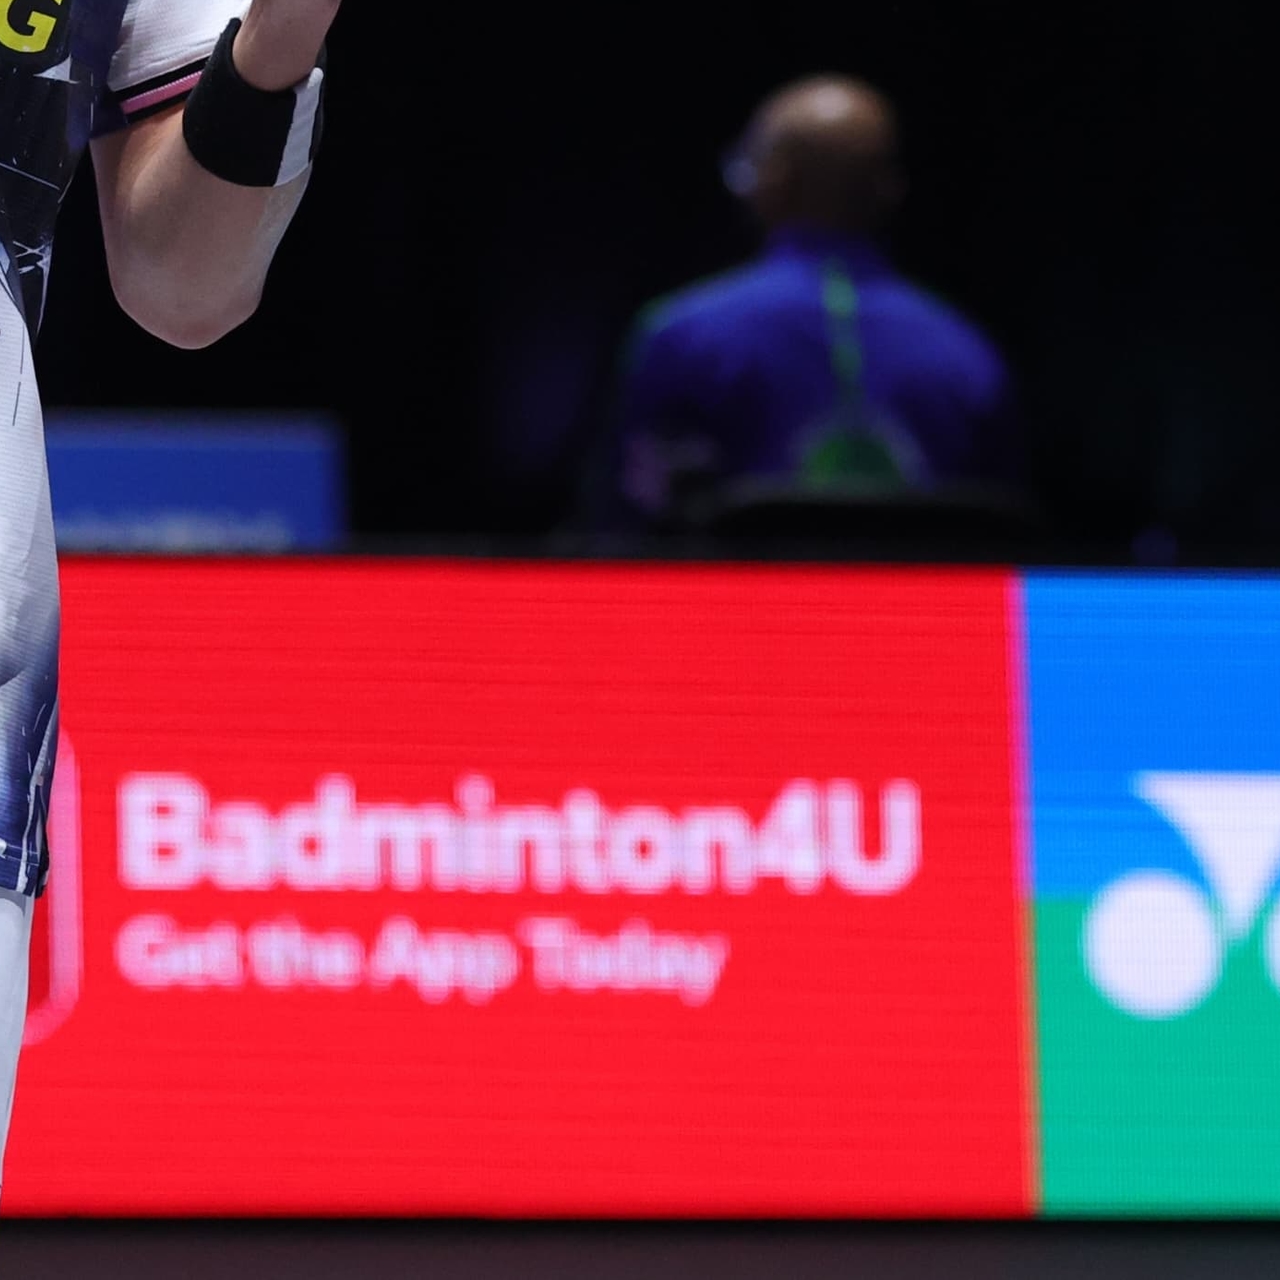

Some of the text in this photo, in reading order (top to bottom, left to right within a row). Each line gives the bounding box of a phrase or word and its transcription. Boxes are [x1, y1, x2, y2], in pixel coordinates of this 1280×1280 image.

[119, 775, 920, 894] Badminton4U
[117, 915, 726, 1003] Get the App Today
